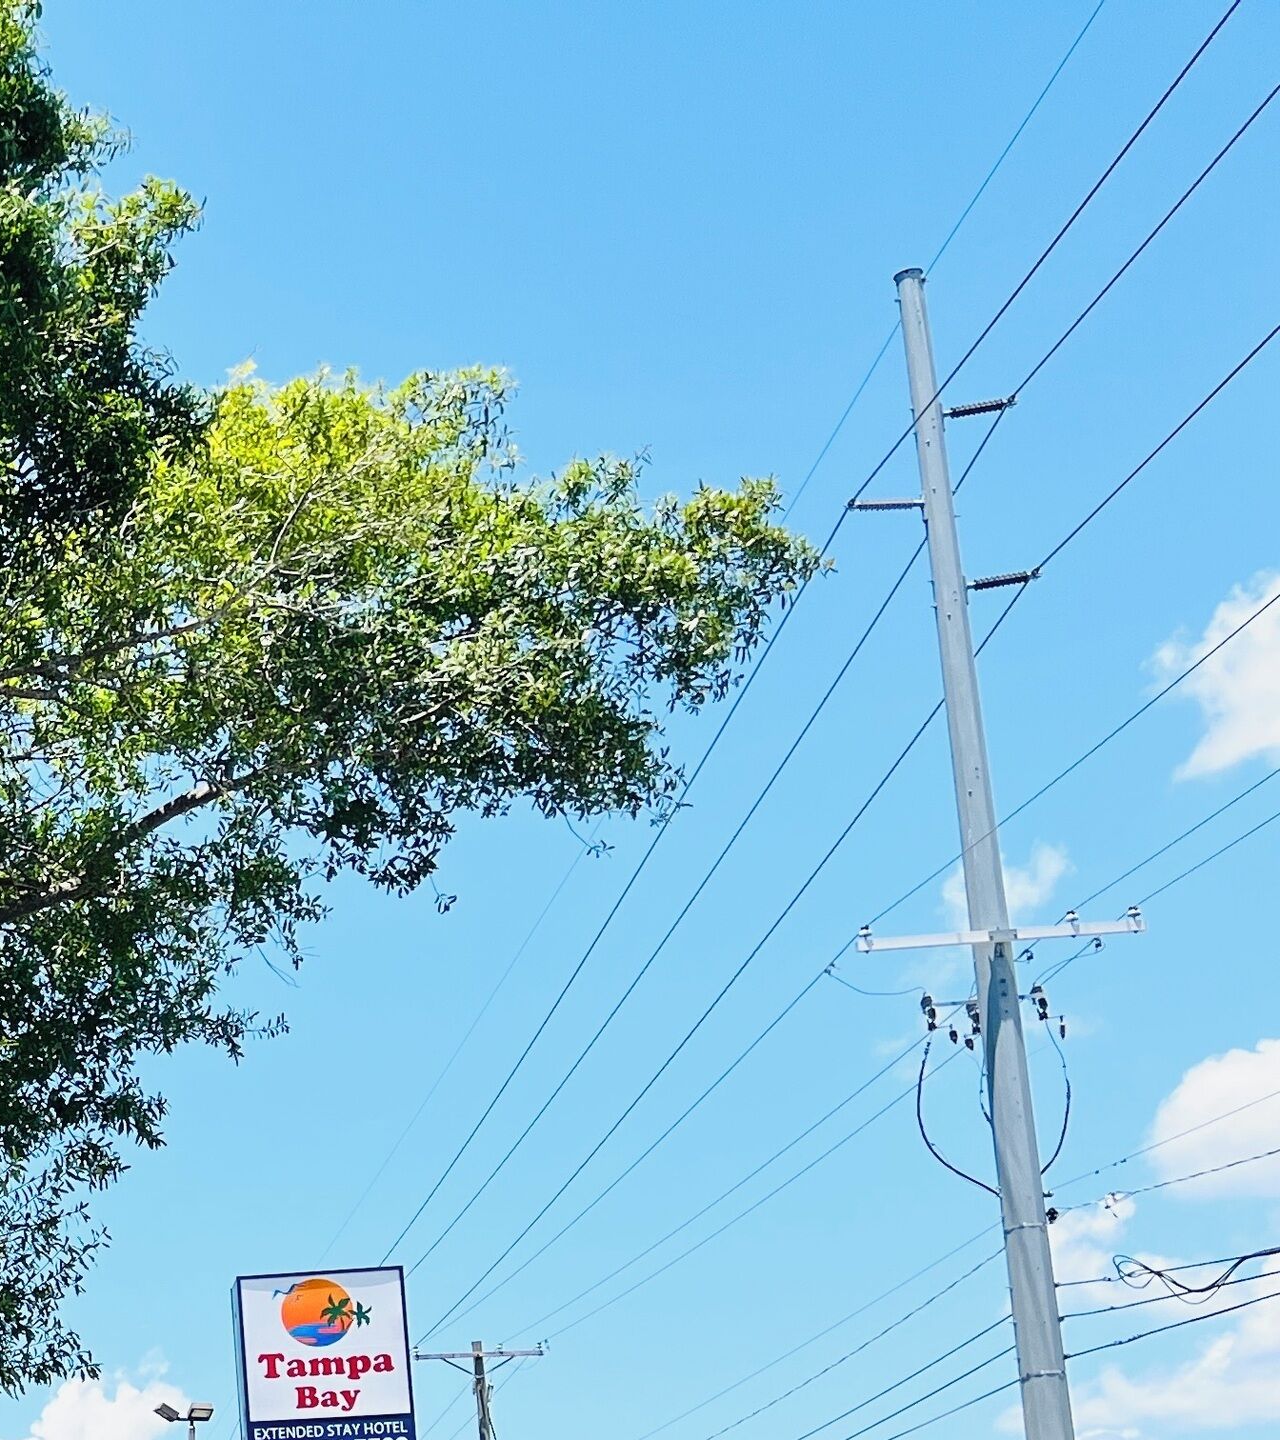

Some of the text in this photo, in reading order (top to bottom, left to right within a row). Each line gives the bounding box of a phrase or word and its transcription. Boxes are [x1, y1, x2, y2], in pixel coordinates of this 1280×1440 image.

[258, 1353, 395, 1379] Tampa
[295, 1386, 361, 1412] Bay
[254, 1421, 408, 1440] EXTENDED STAY HOTEL
